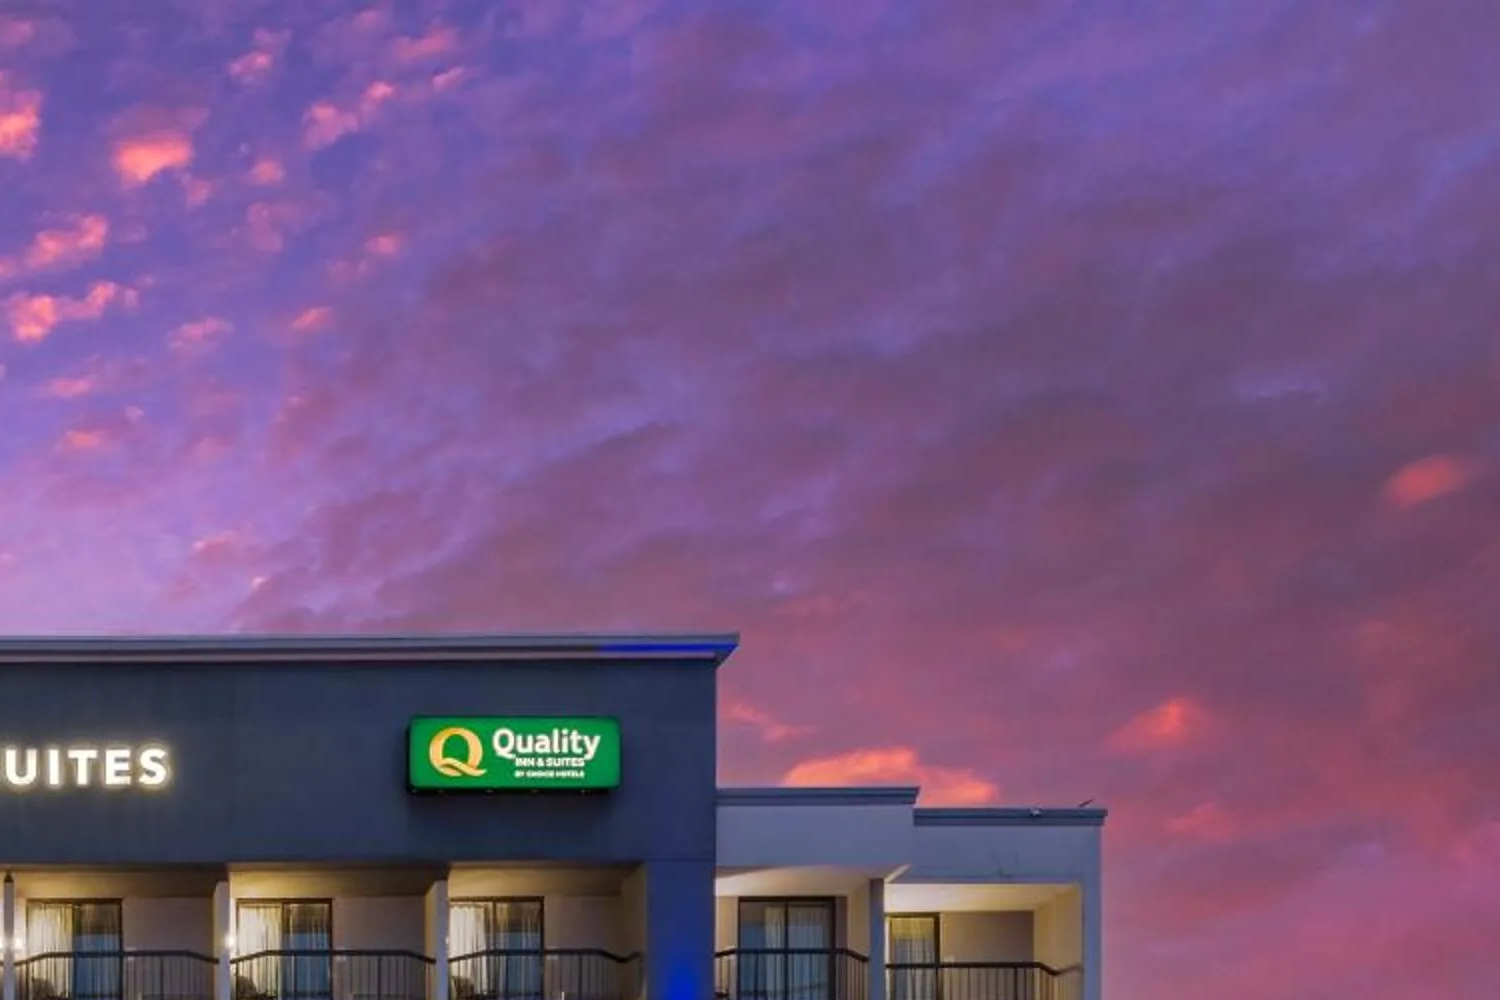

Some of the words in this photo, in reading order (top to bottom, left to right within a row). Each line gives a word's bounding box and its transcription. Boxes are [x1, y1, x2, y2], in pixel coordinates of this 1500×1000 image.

[492, 727, 601, 760] Quality
[515, 757, 535, 767] INN
[546, 757, 585, 767] SUITES
